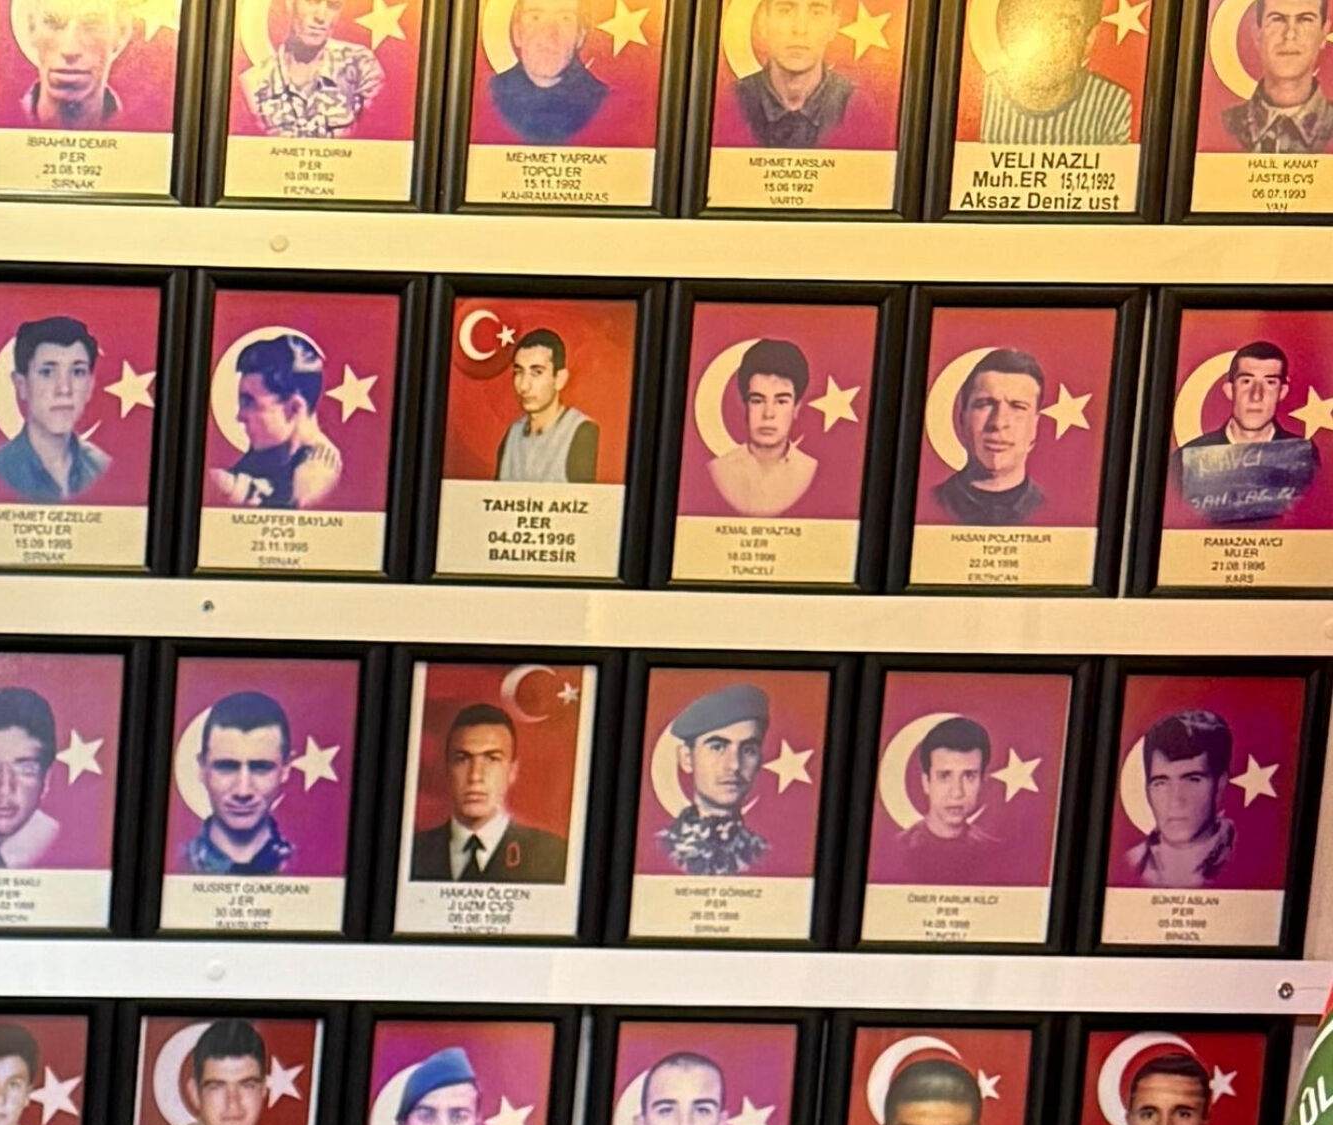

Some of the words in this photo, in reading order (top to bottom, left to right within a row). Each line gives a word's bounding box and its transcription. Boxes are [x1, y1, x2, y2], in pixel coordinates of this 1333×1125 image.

[506, 152, 557, 163] MEHMET
[560, 153, 607, 165] YAPRAK
[749, 157, 793, 167] MEHMET
[991, 152, 1035, 169] VELI
[1041, 152, 1100, 169] NAZLI
[565, 167, 582, 177] ER
[973, 171, 1047, 188] Muh.ER
[960, 191, 1021, 209] Aksaz
[1027, 192, 1082, 210] Deniz
[1089, 194, 1119, 210] ust
[482, 498, 543, 512] TAHSİN
[548, 500, 589, 514] AKİZ
[517, 516, 551, 529] P.ER
[55, 525, 71, 535] ER
[488, 531, 575, 545] 04.02.1996
[1204, 537, 1256, 547] RAMAZAN
[489, 548, 576, 563] BALIKESİR
[440, 888, 484, 898] HAKAN
